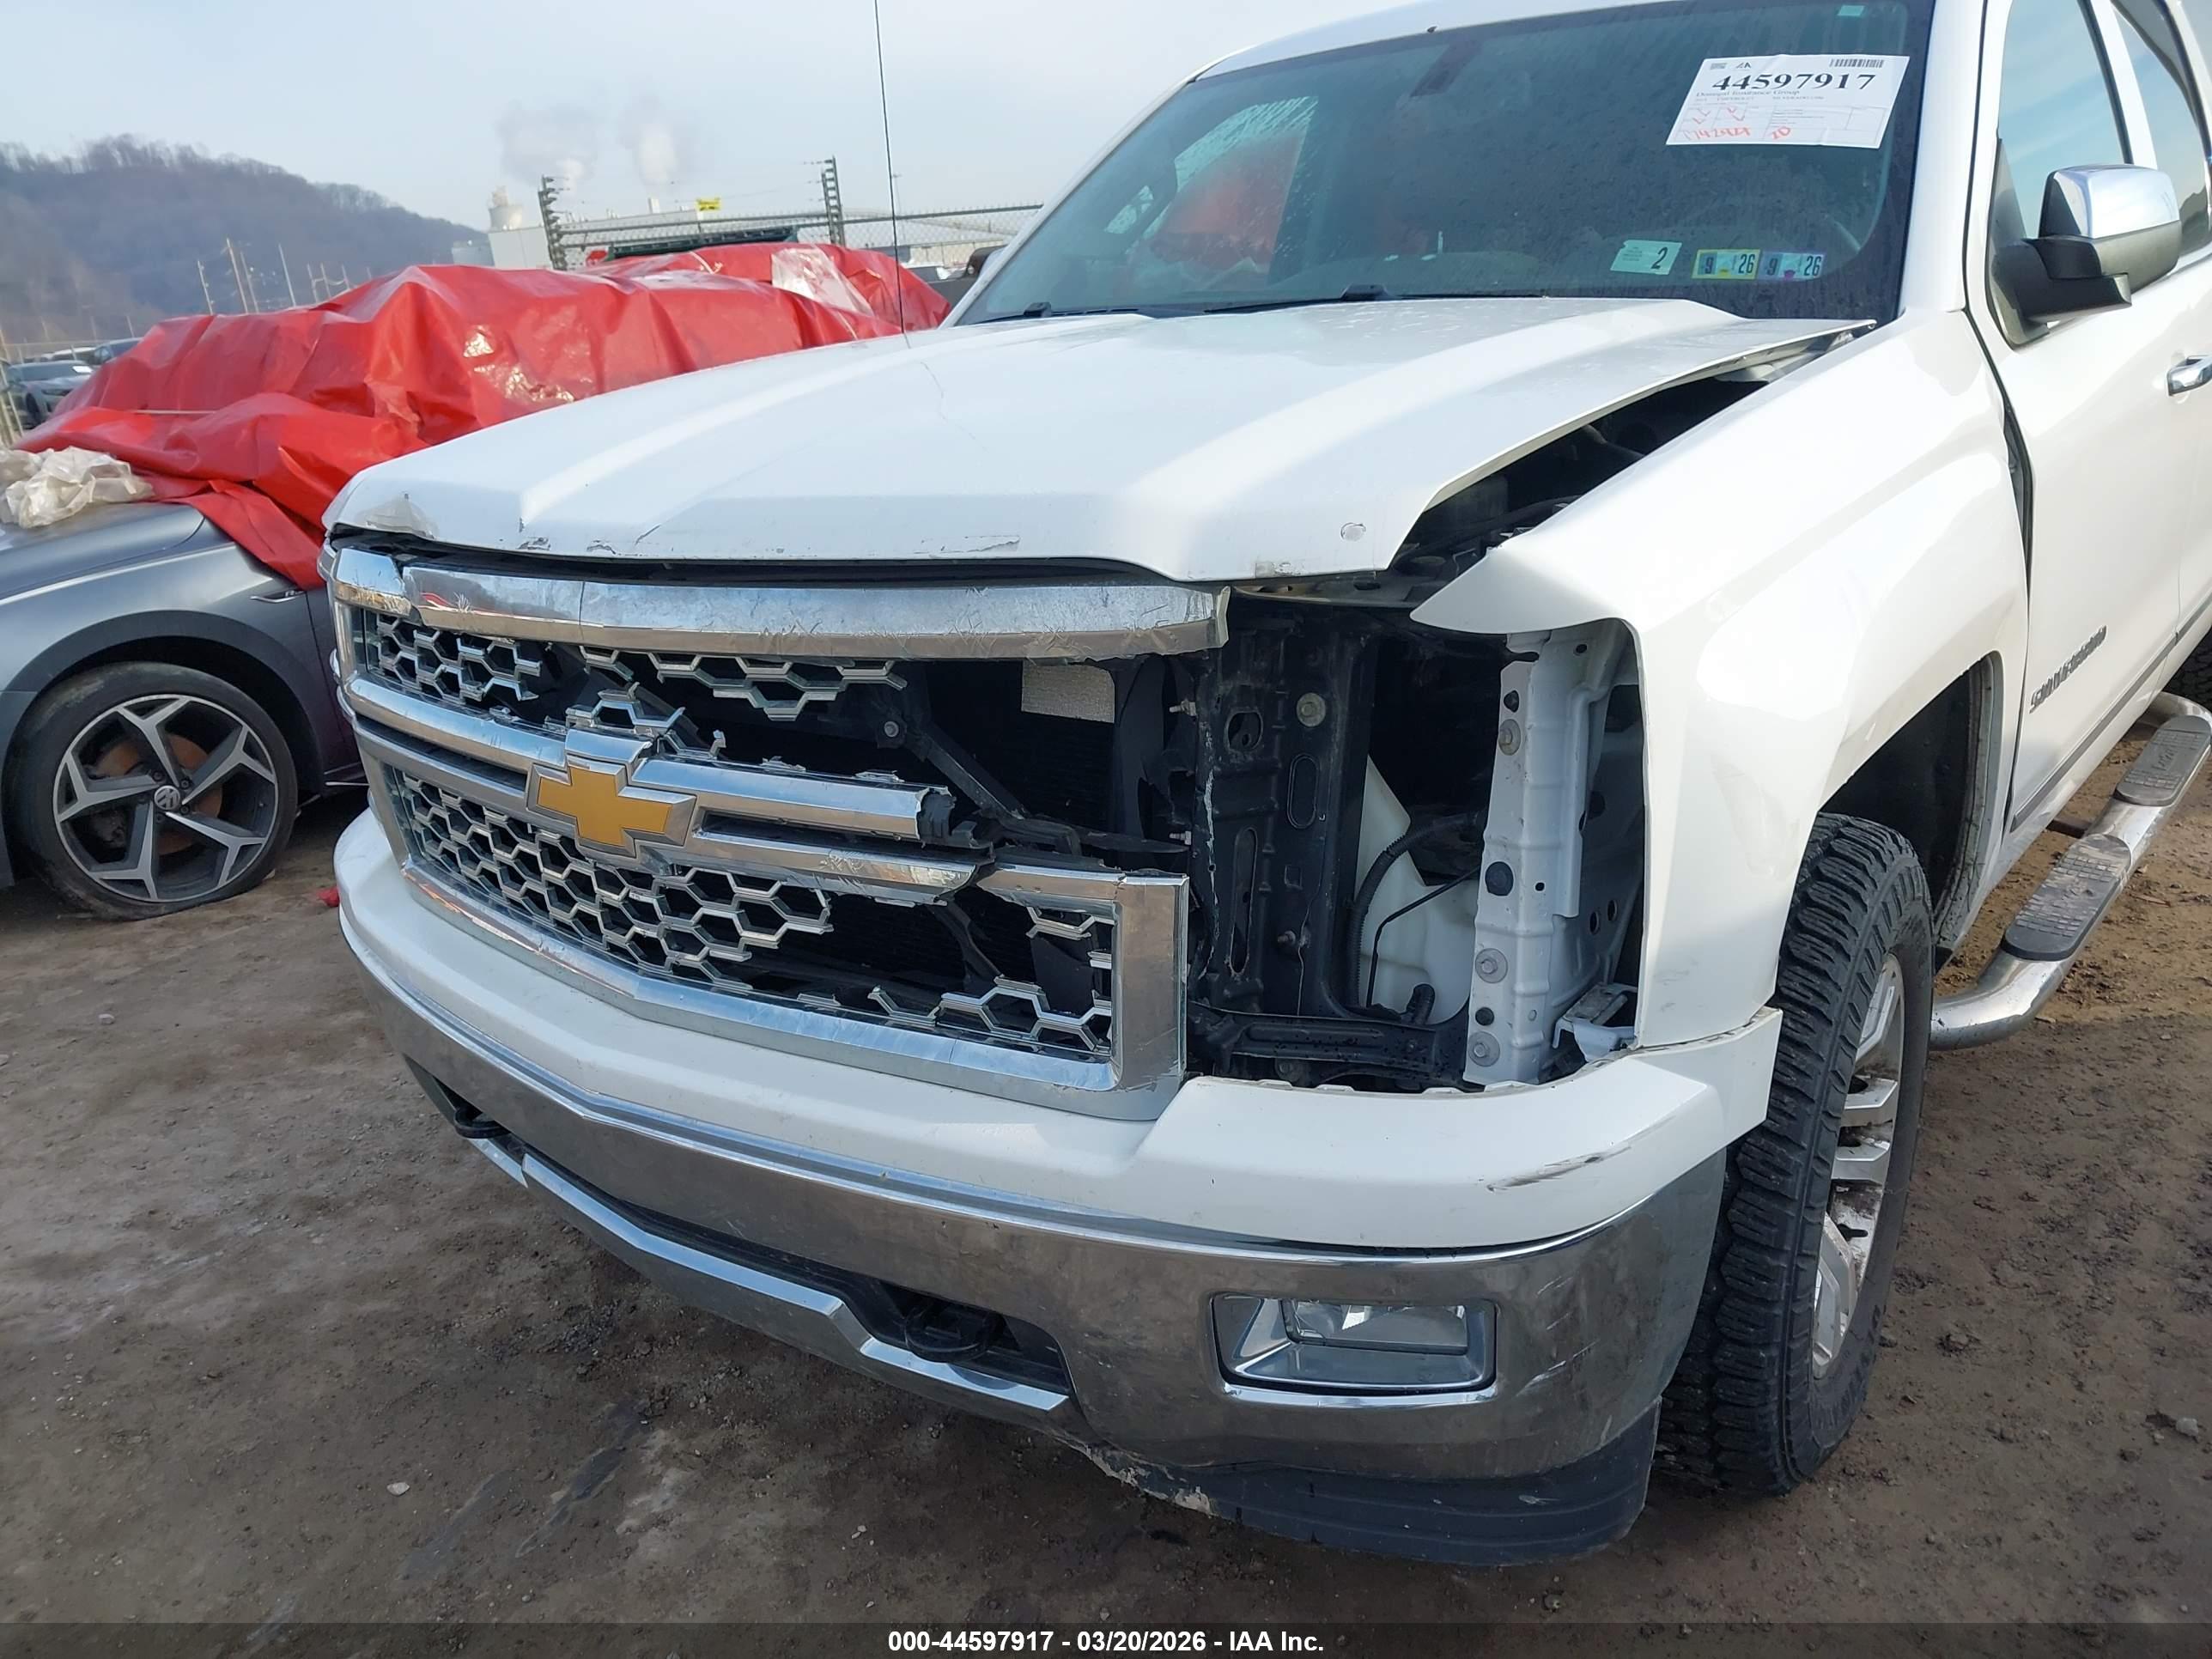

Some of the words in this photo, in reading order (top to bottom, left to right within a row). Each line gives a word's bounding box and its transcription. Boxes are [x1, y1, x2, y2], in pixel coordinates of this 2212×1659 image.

[1711, 72, 1875, 90] 44597917
[1650, 246, 1668, 270] 2
[1704, 257, 1714, 274] 9
[1738, 253, 1756, 274] 26
[1765, 257, 1778, 276] 9
[1803, 255, 1822, 276] 26
